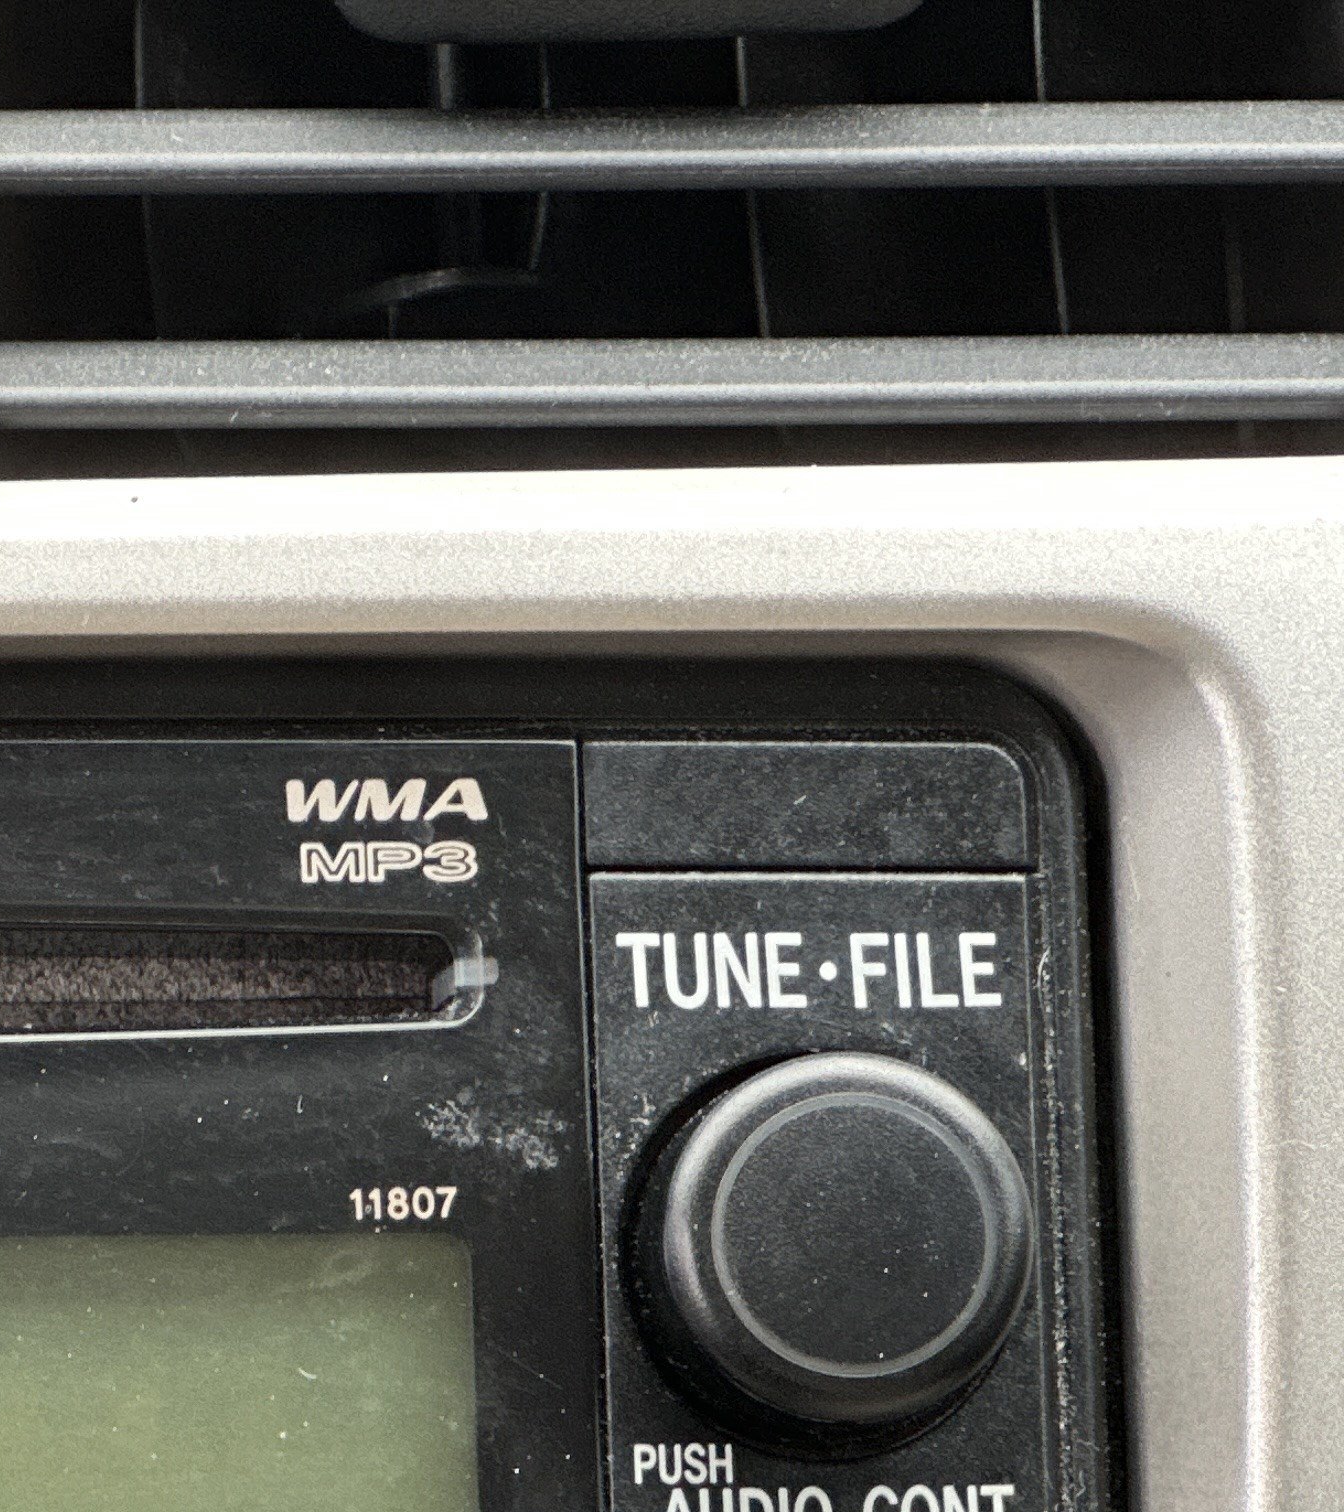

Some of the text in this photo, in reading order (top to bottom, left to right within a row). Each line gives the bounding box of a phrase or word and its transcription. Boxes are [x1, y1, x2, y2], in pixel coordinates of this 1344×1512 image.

[285, 779, 488, 822] WMA
[301, 840, 478, 884] MP3
[349, 1186, 457, 1221] 11807
[634, 1444, 734, 1485] PUSH
